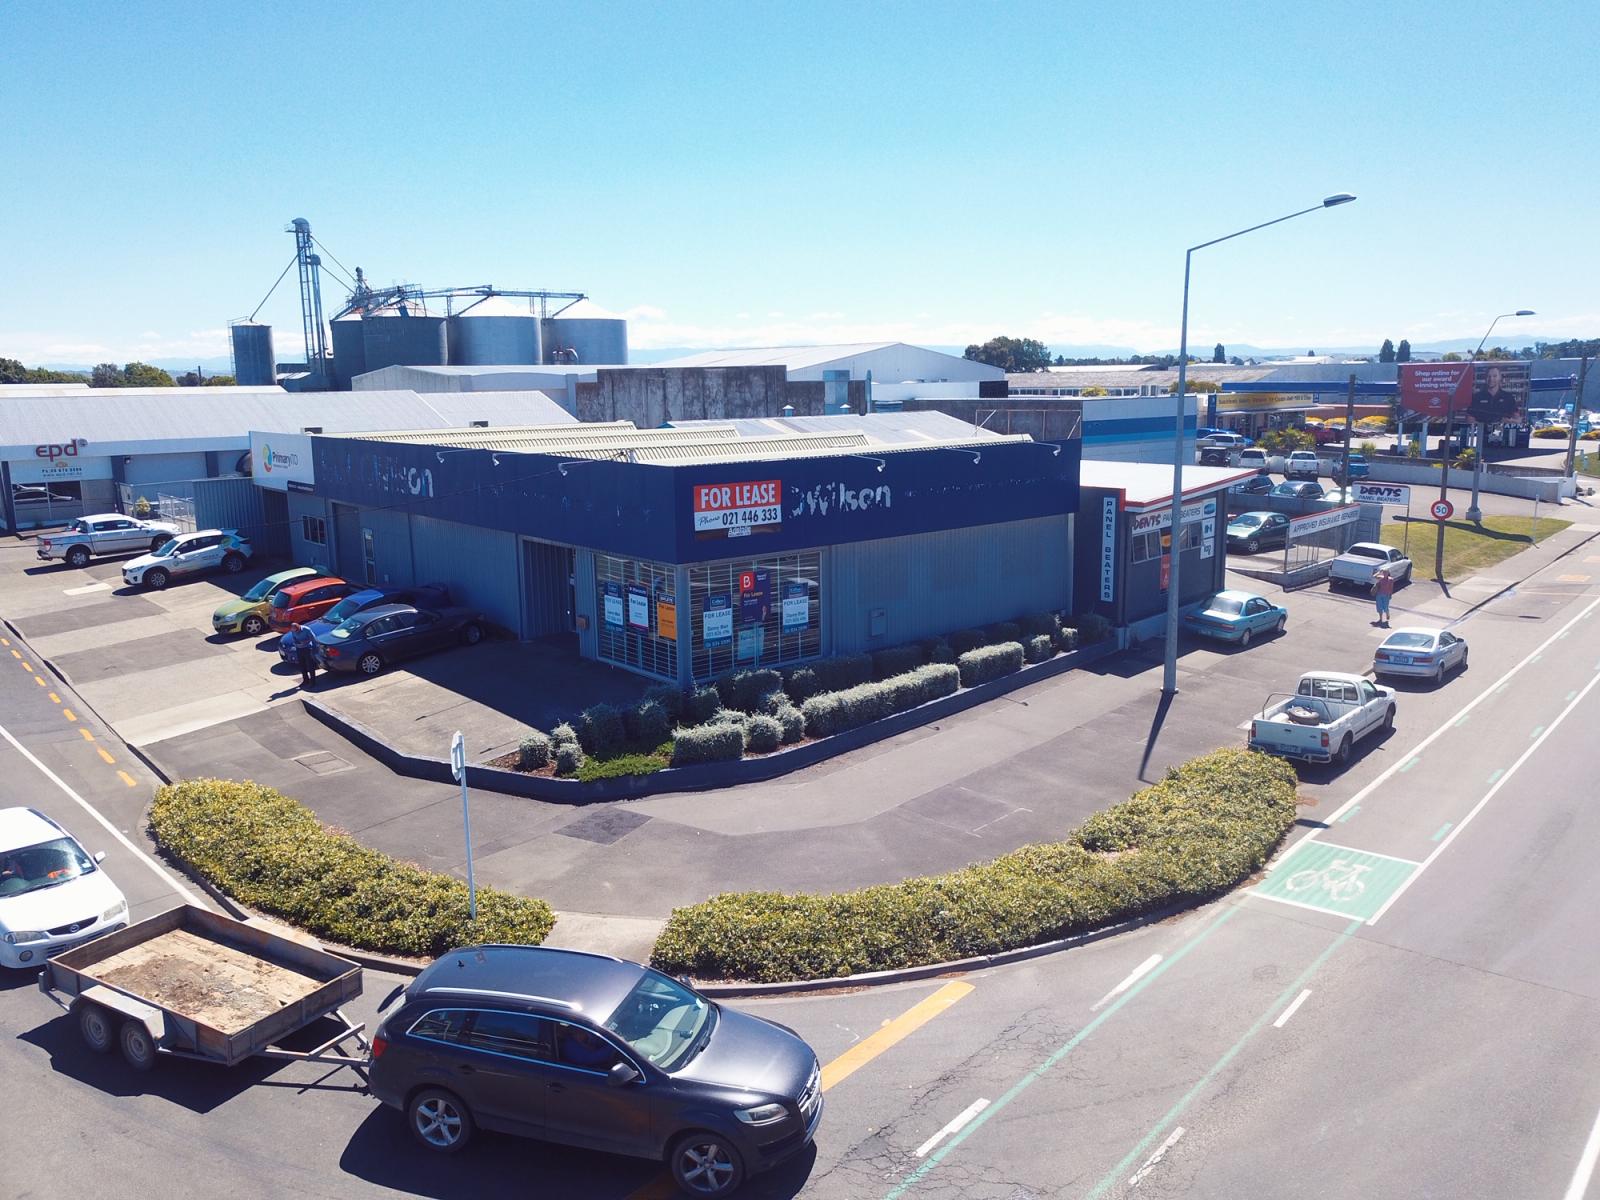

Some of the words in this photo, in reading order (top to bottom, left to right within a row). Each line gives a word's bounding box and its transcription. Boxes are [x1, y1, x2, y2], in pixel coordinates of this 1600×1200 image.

[35, 438, 78, 462] epd
[700, 487, 732, 509] FOR
[735, 482, 776, 506] LEASE
[1359, 485, 1402, 498] DENTS
[699, 515, 721, 527] Phone
[722, 511, 739, 526] 021
[741, 509, 759, 524] 446
[761, 507, 778, 522] 333
[1105, 500, 1113, 538] PANEL
[1436, 505, 1447, 515] 50
[1133, 513, 1161, 531] DENTS
[743, 575, 751, 588] B
[1103, 546, 1112, 599] BEATERS
[715, 610, 731, 618] LEASE
